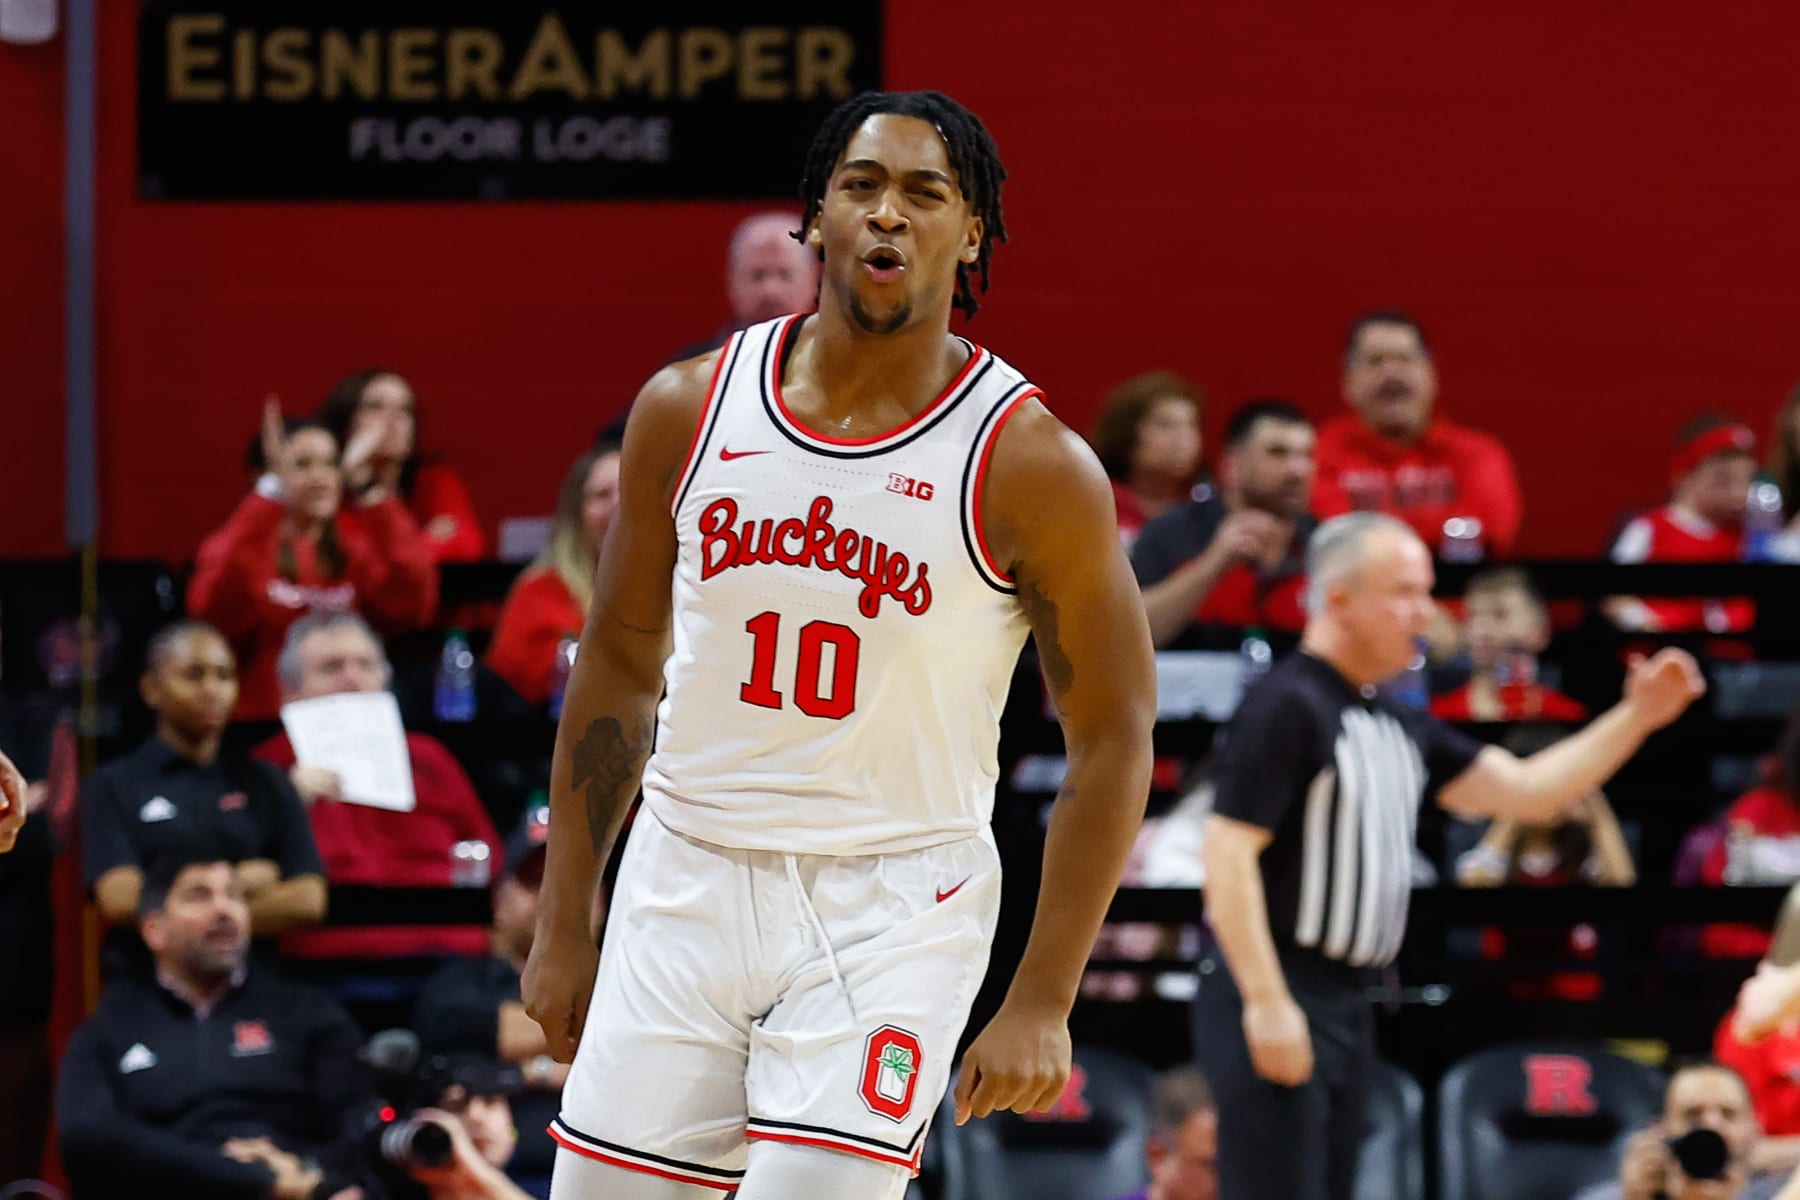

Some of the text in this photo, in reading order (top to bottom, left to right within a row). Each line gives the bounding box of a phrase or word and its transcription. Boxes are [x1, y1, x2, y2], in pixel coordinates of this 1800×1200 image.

[350, 116, 671, 162] FLOOR LOGE
[698, 496, 932, 618] Buckeyes
[740, 611, 861, 720] 10
[1525, 1055, 1596, 1116] R
